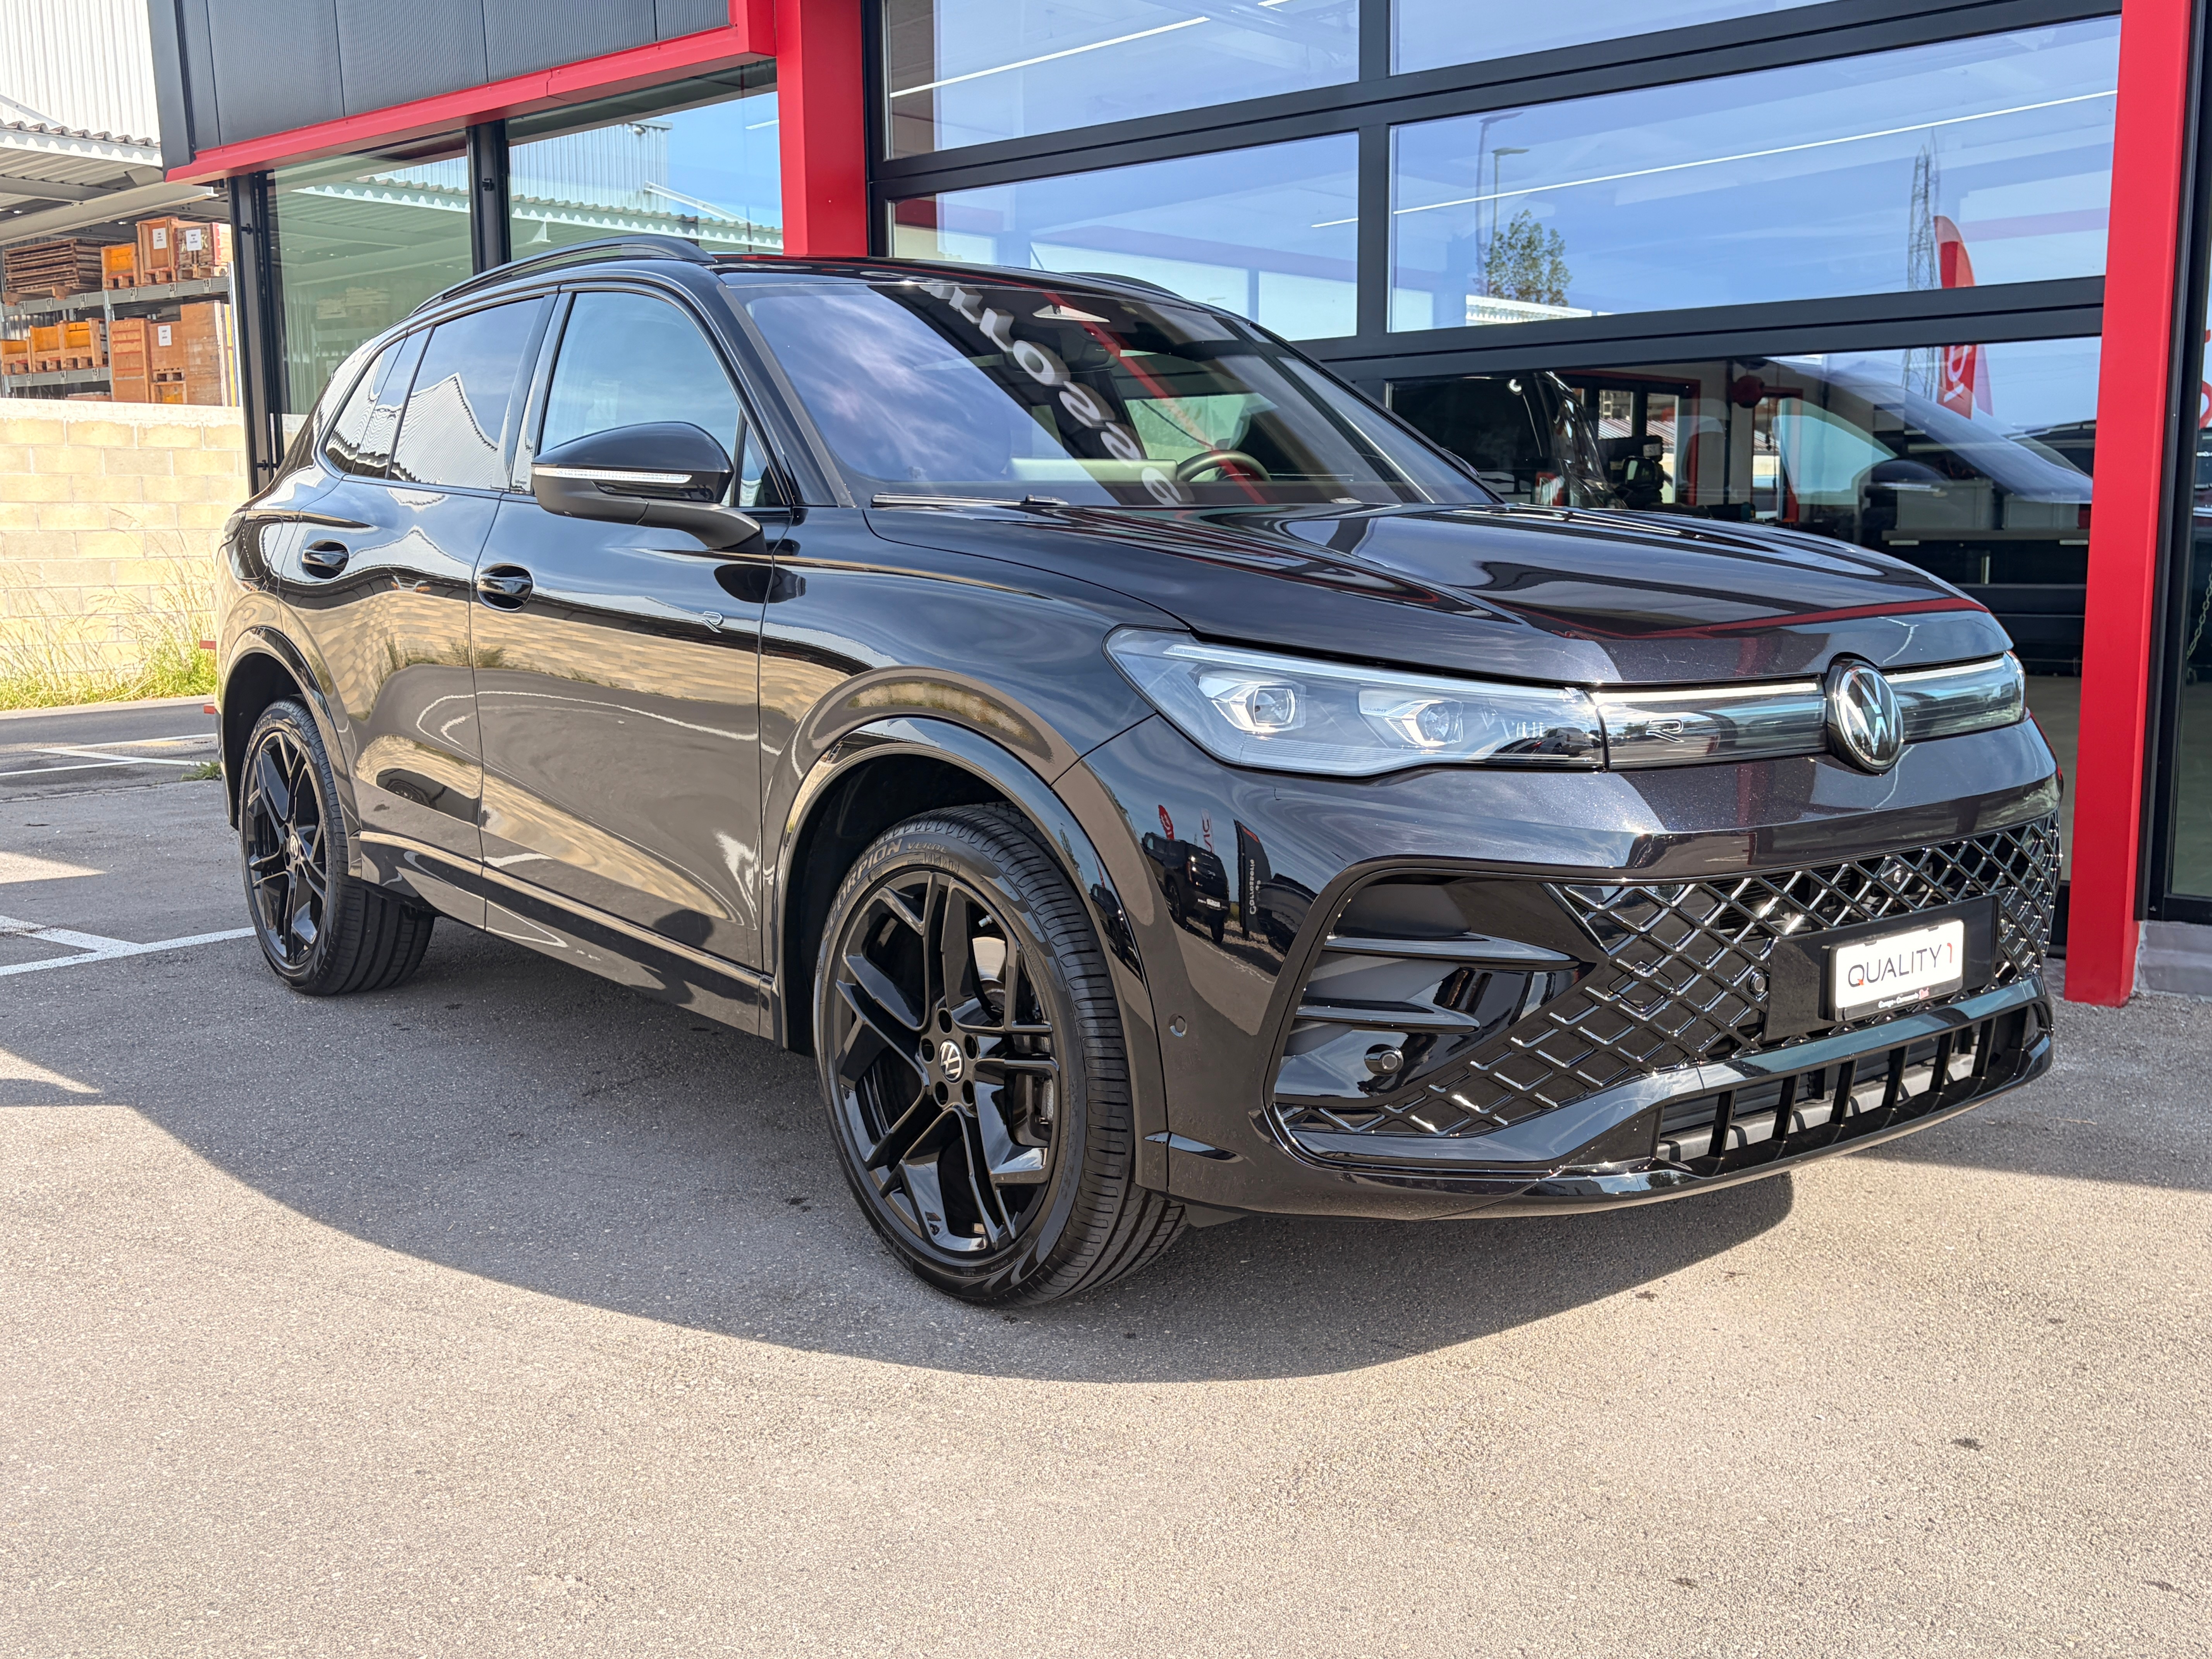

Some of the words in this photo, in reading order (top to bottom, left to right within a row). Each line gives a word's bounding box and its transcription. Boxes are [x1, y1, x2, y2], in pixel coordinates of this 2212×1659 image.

[701, 611, 723, 633] R
[1645, 719, 1684, 743] R
[907, 842, 950, 854] VERDE
[1848, 944, 1942, 988] QUALITY
